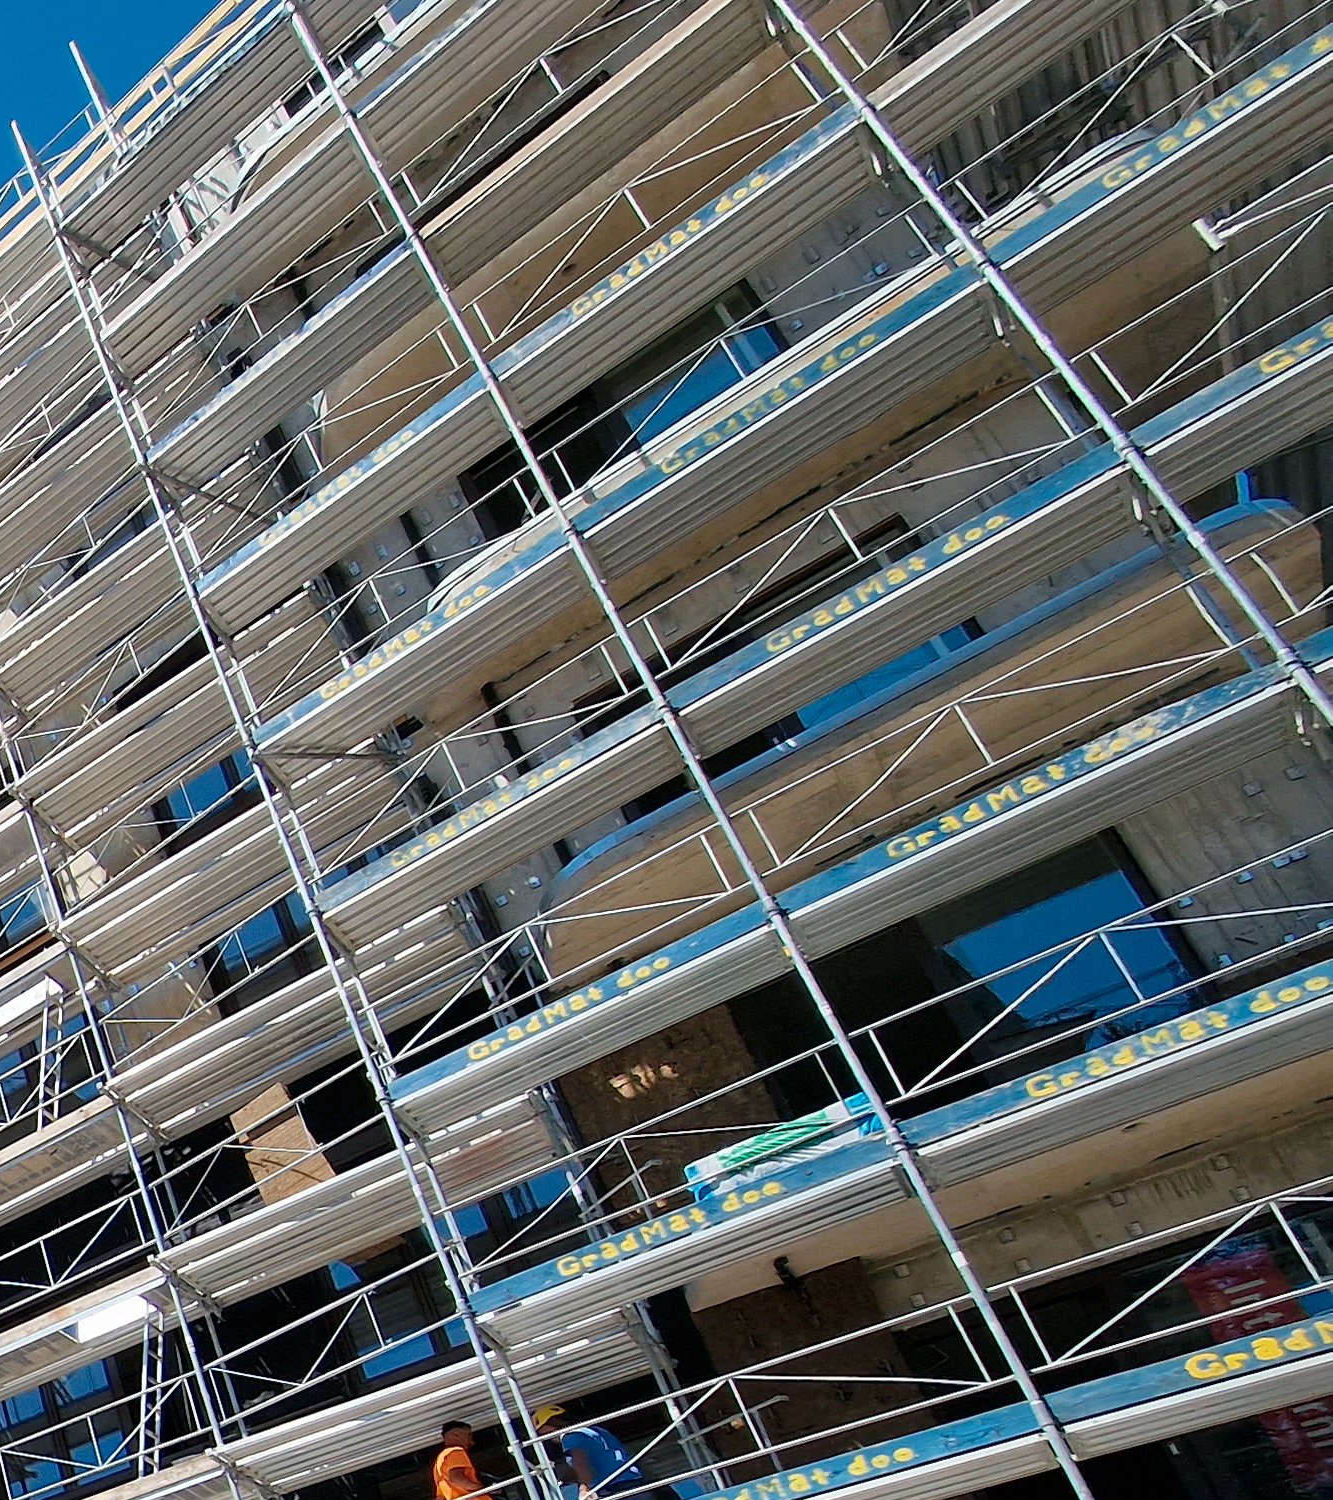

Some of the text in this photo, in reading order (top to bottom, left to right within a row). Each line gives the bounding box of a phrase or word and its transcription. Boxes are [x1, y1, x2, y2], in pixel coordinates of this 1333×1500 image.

[1103, 64, 1290, 189] GradMat
[766, 557, 926, 653] GradMat
[886, 763, 1067, 859] GradMat
[467, 987, 604, 1061] GradMat
[1026, 1006, 1230, 1099] GradMat
[557, 1205, 706, 1277] GradMat
